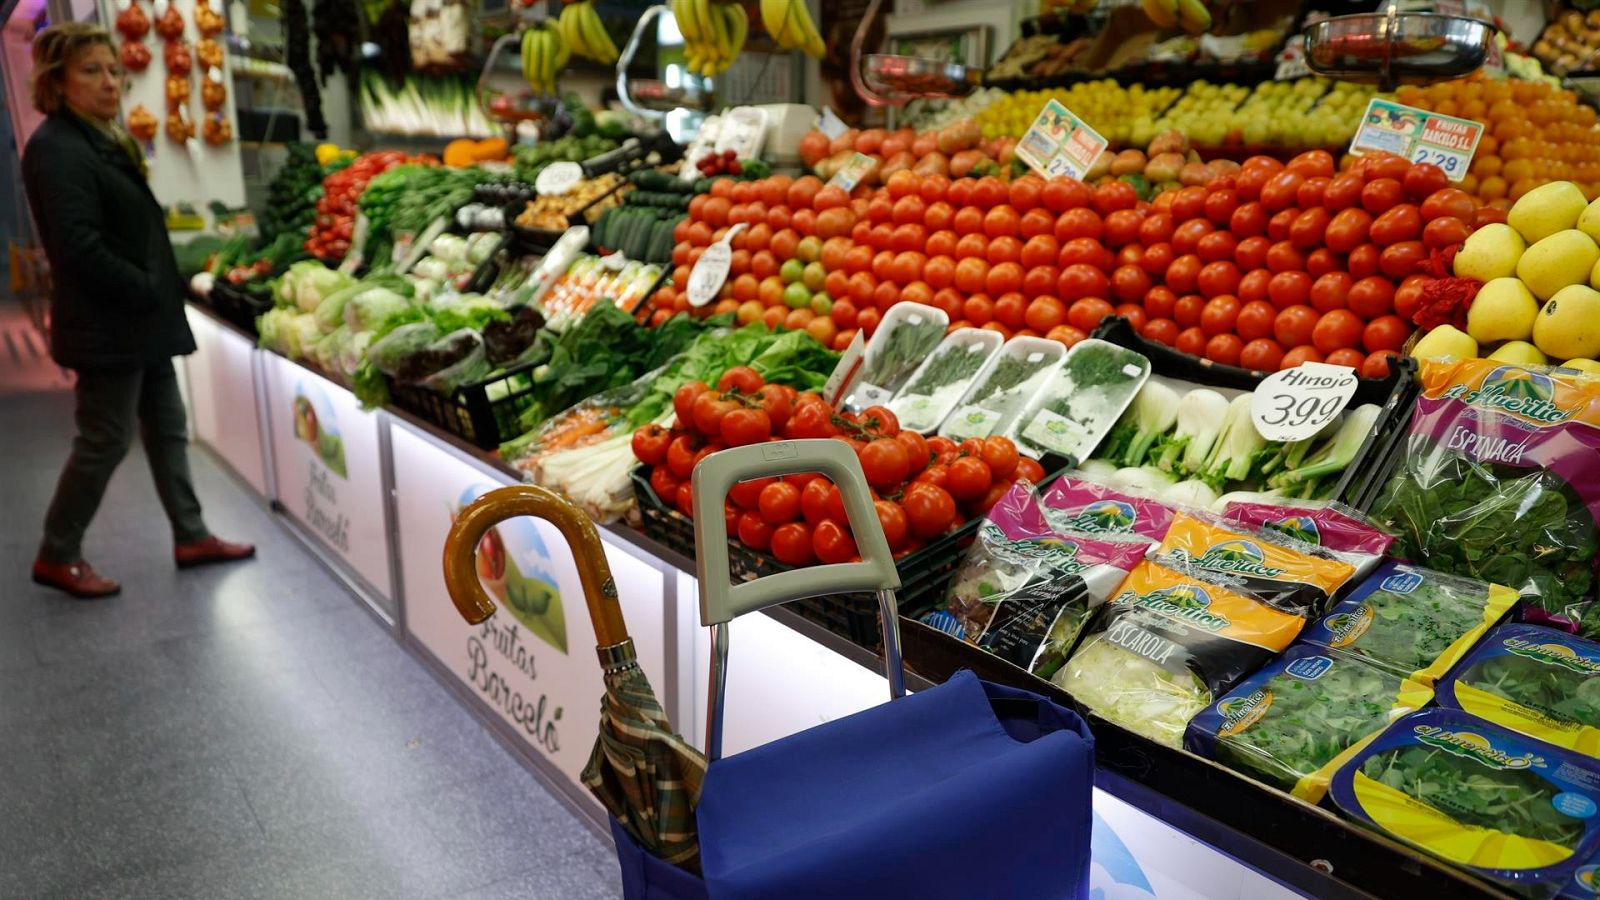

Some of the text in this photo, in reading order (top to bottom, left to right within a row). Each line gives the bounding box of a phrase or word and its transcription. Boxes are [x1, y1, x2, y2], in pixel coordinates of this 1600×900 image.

[1279, 369, 1354, 391] Hinojo
[1465, 385, 1573, 424] Huertic
[1447, 424, 1528, 464] ESPINACA
[1109, 620, 1178, 665] ESCAROLA
[467, 636, 563, 753] Barceló
